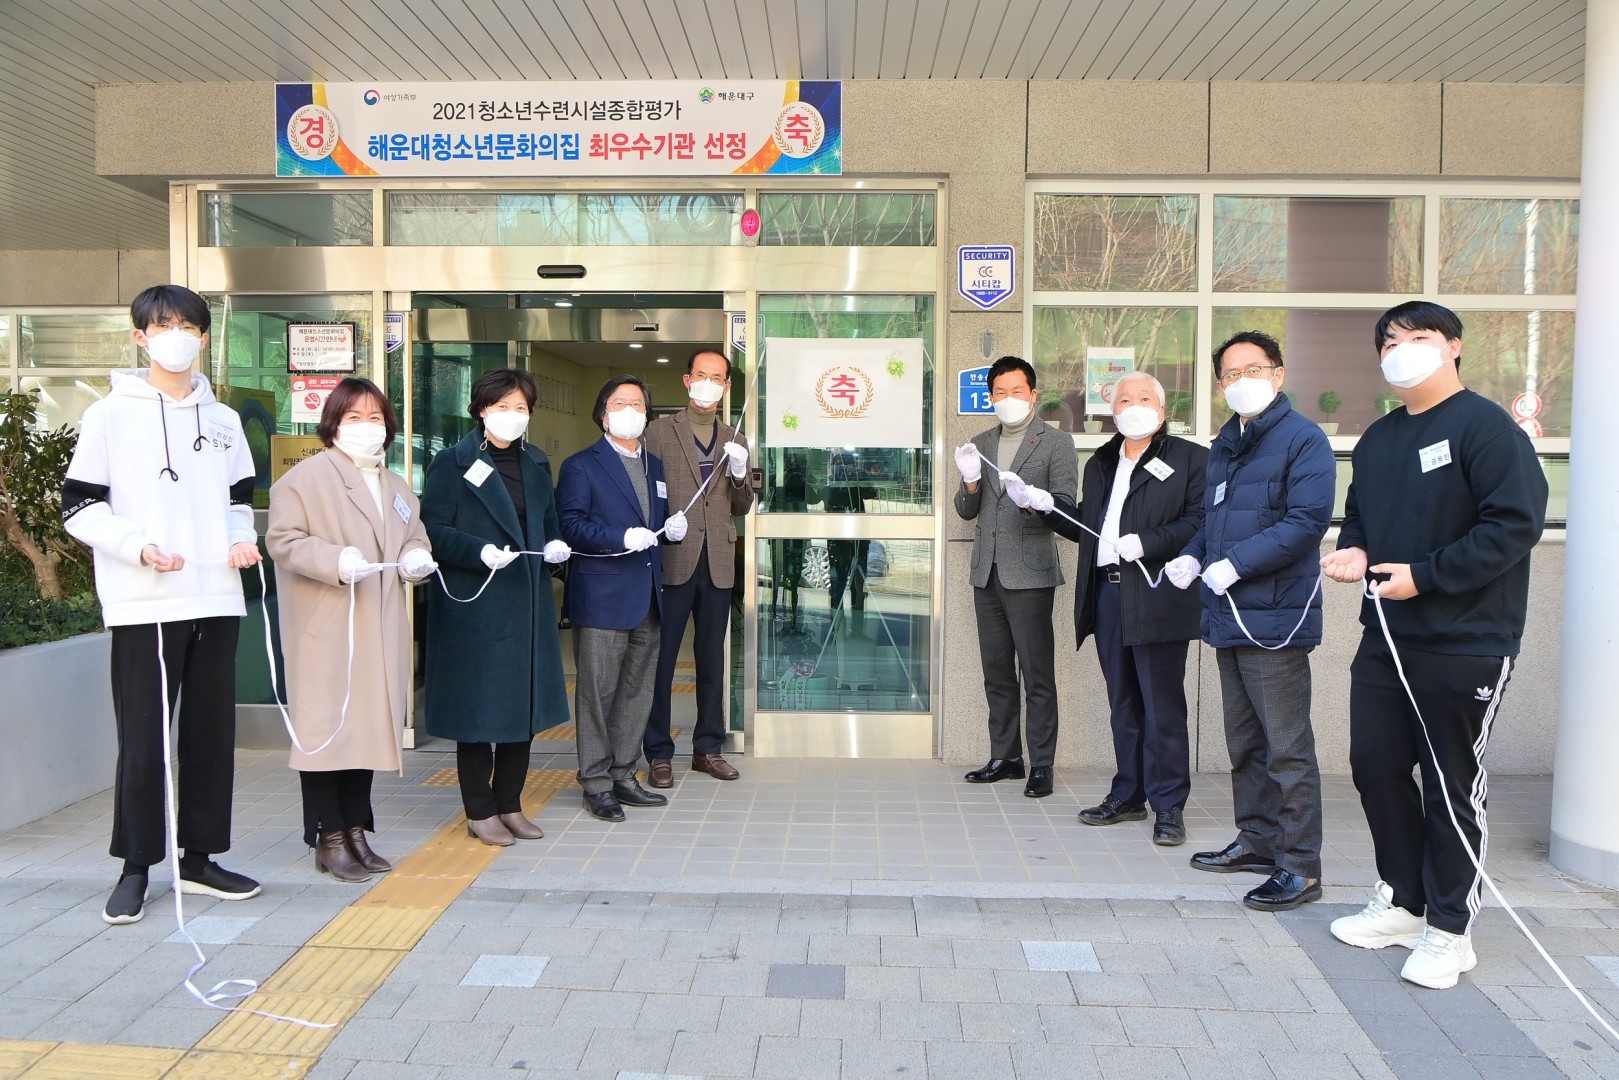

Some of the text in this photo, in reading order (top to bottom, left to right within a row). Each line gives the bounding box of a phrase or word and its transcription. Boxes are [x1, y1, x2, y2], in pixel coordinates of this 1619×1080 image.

[383, 93, 417, 102] 여성가족부
[718, 91, 755, 101] 해운대구
[432, 99, 682, 121] 2021청소년수련시설종합평가
[299, 115, 325, 149] 경
[783, 113, 812, 147] 축
[368, 132, 747, 162] 해운대청소년문화의집 최우수기관 선정
[965, 252, 1008, 260] SECURITY
[971, 279, 1002, 289] 시티캅
[825, 373, 861, 407] 축
